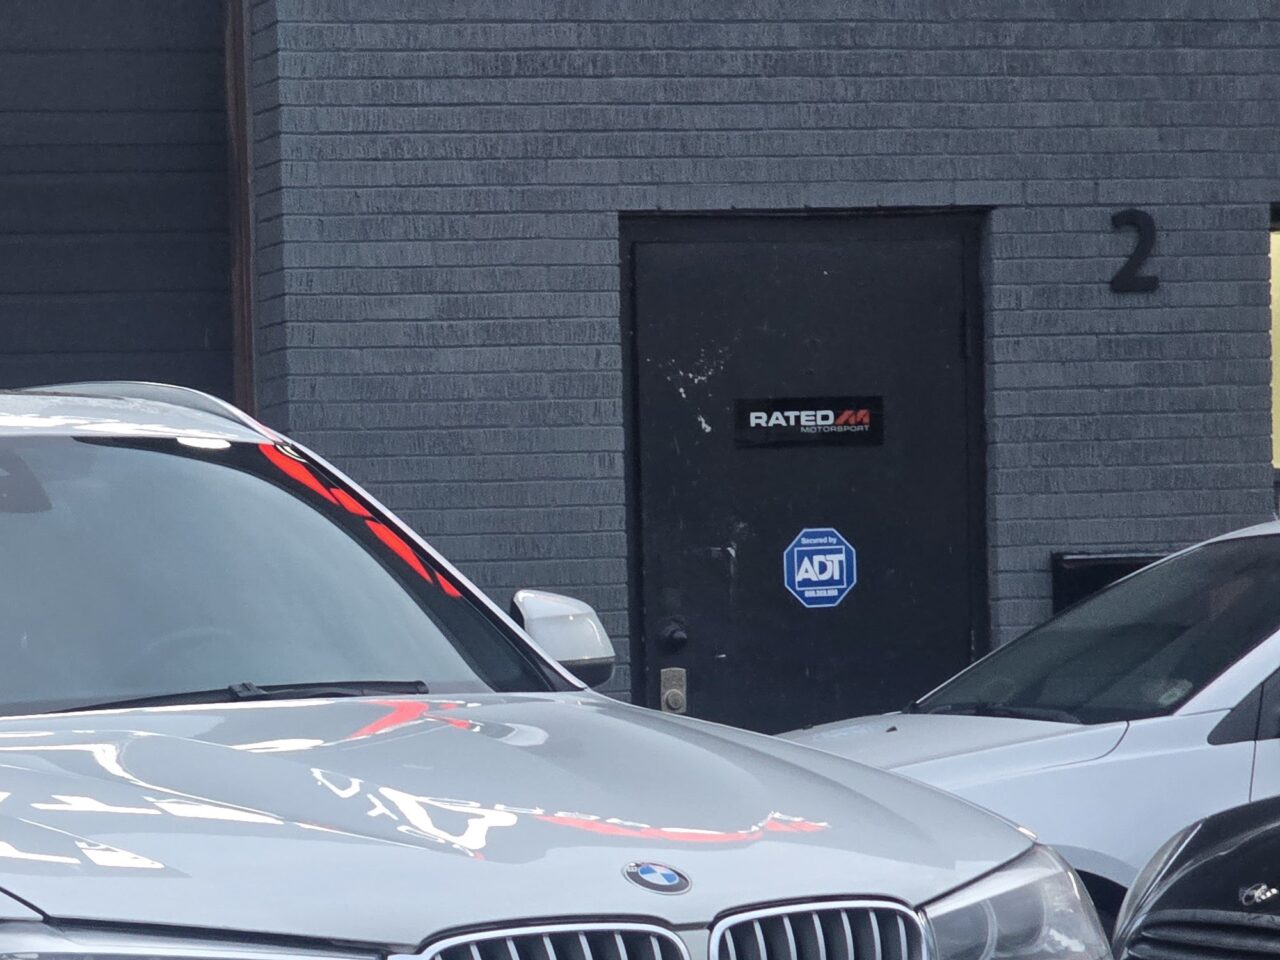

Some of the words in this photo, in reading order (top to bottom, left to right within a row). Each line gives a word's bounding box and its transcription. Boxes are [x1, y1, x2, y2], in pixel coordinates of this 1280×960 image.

[1110, 208, 1160, 293] 2
[749, 410, 835, 427] RATED
[800, 425, 870, 433] MOTORSPORT
[796, 554, 844, 582] ADT
